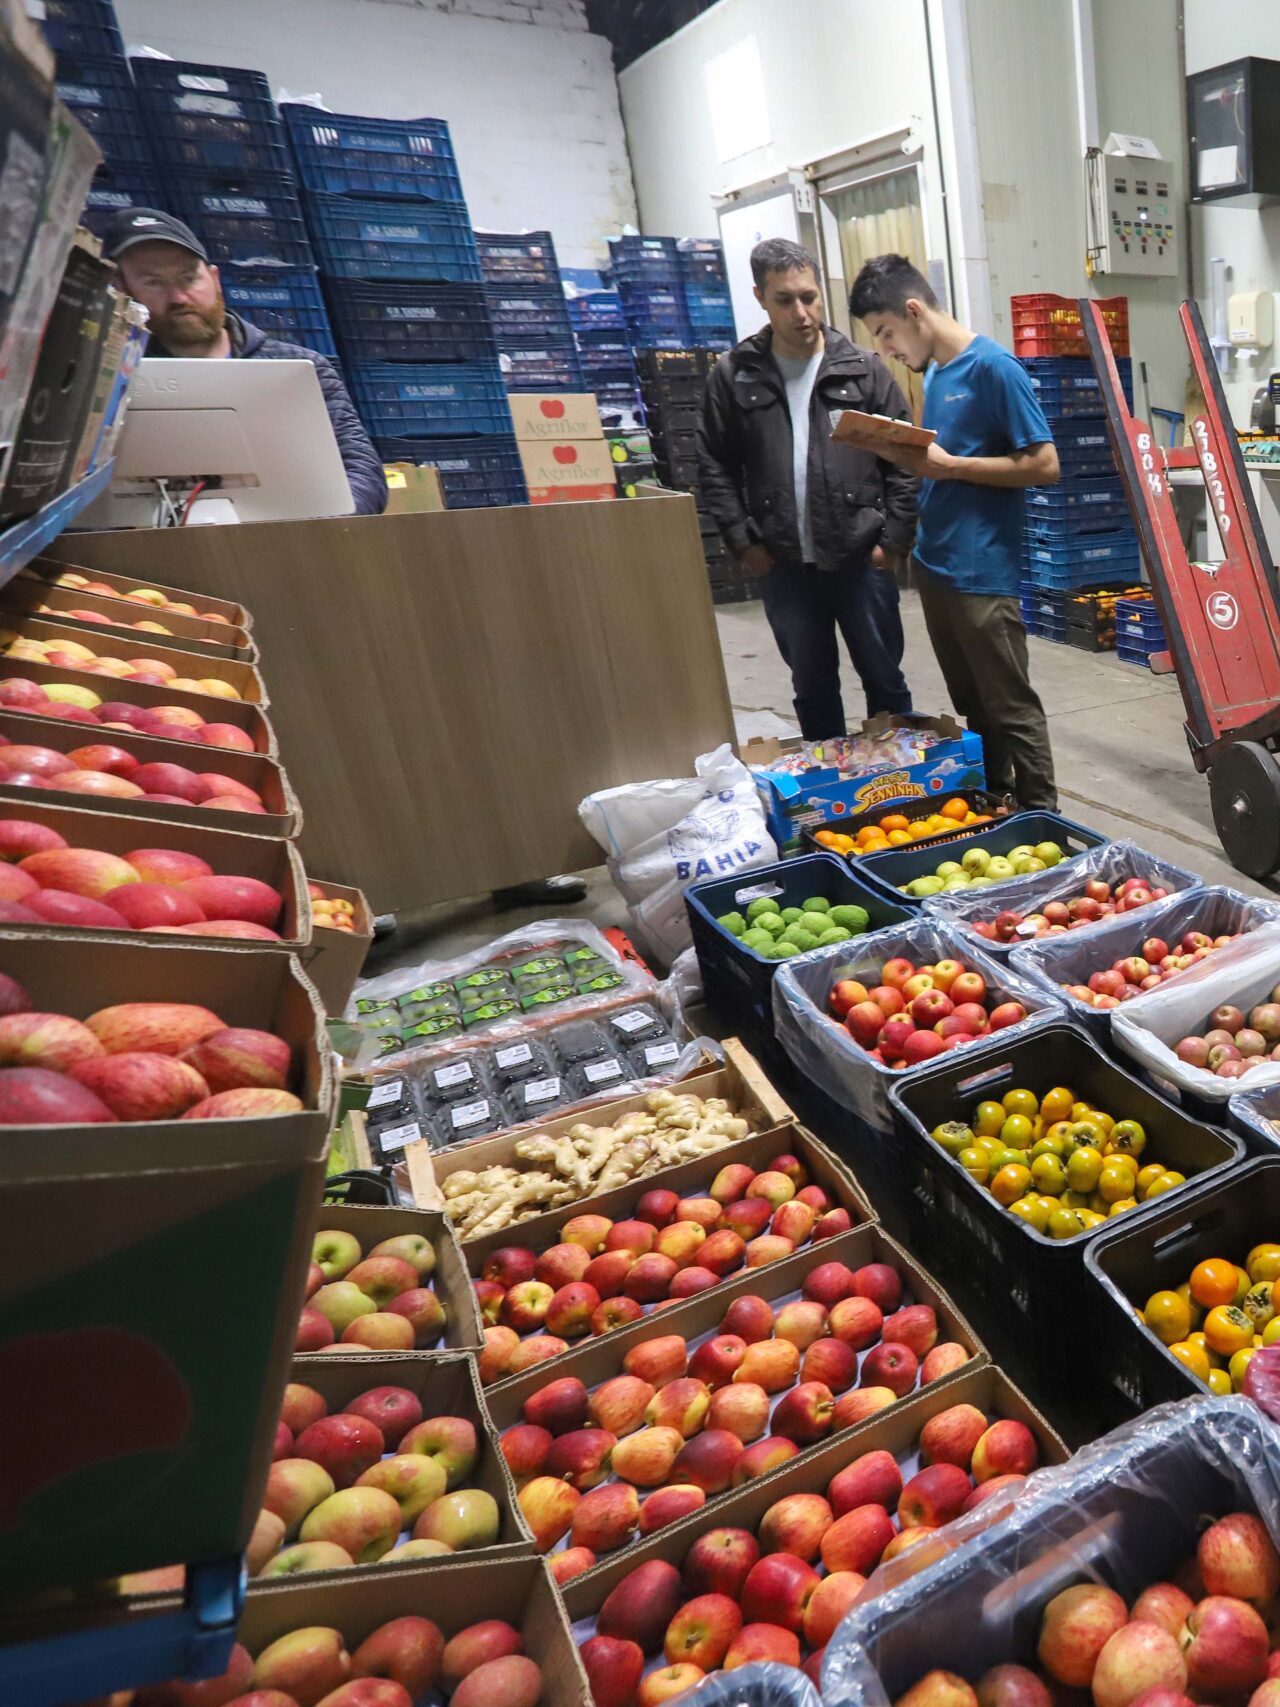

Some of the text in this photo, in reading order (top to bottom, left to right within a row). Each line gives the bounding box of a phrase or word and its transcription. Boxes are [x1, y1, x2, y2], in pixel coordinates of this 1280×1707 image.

[525, 420, 590, 437] Agriflor
[538, 465, 601, 481] Agriflor
[1213, 596, 1233, 622] 5
[850, 783, 928, 815] SENNINHA
[676, 840, 762, 880] BAHIA
